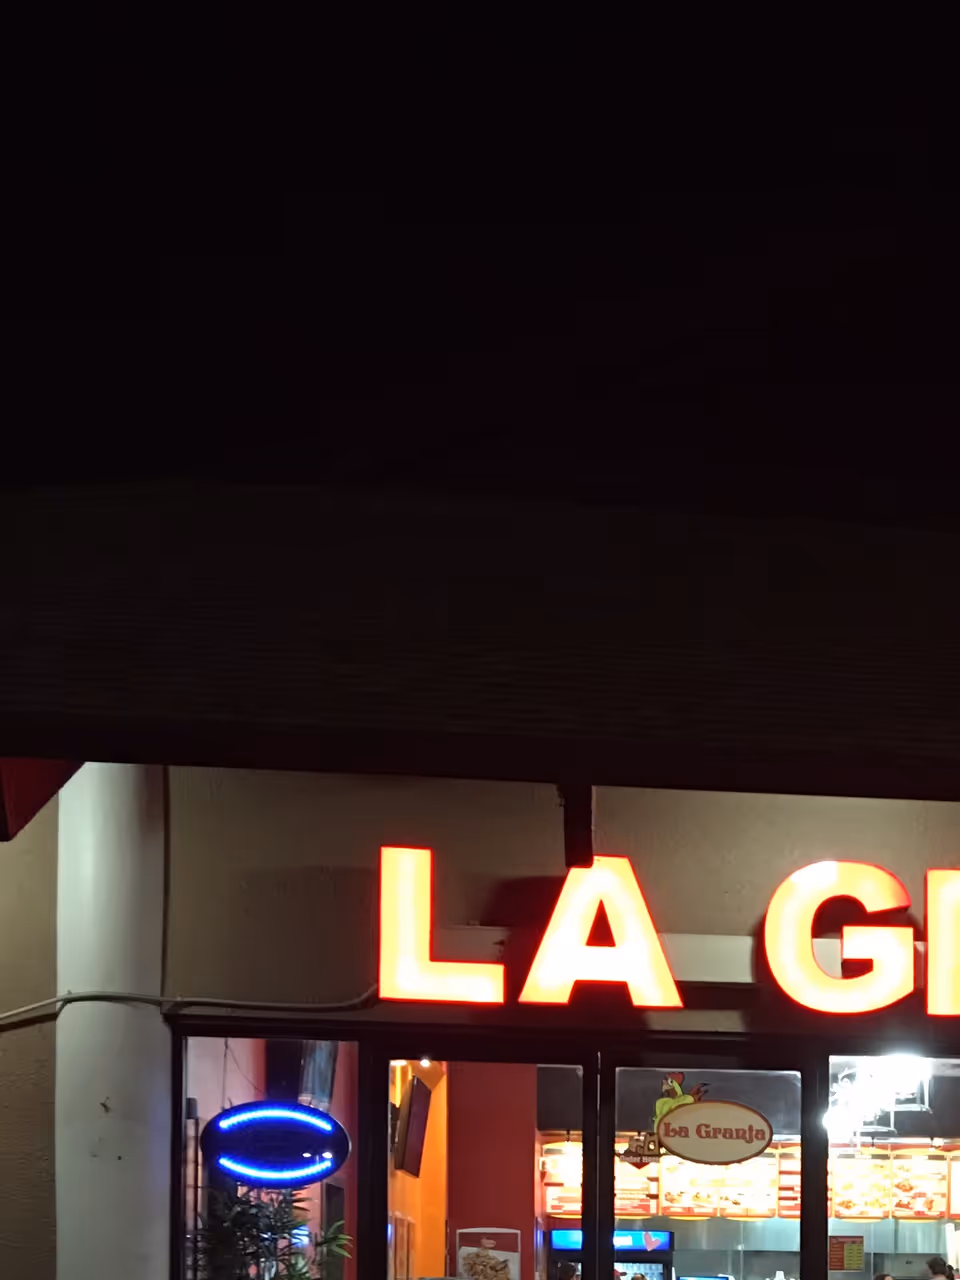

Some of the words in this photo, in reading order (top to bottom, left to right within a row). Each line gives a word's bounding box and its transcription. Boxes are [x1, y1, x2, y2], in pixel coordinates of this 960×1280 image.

[379, 846, 685, 1009] LA
[663, 1122, 690, 1138] La
[695, 1123, 766, 1144] Granja
